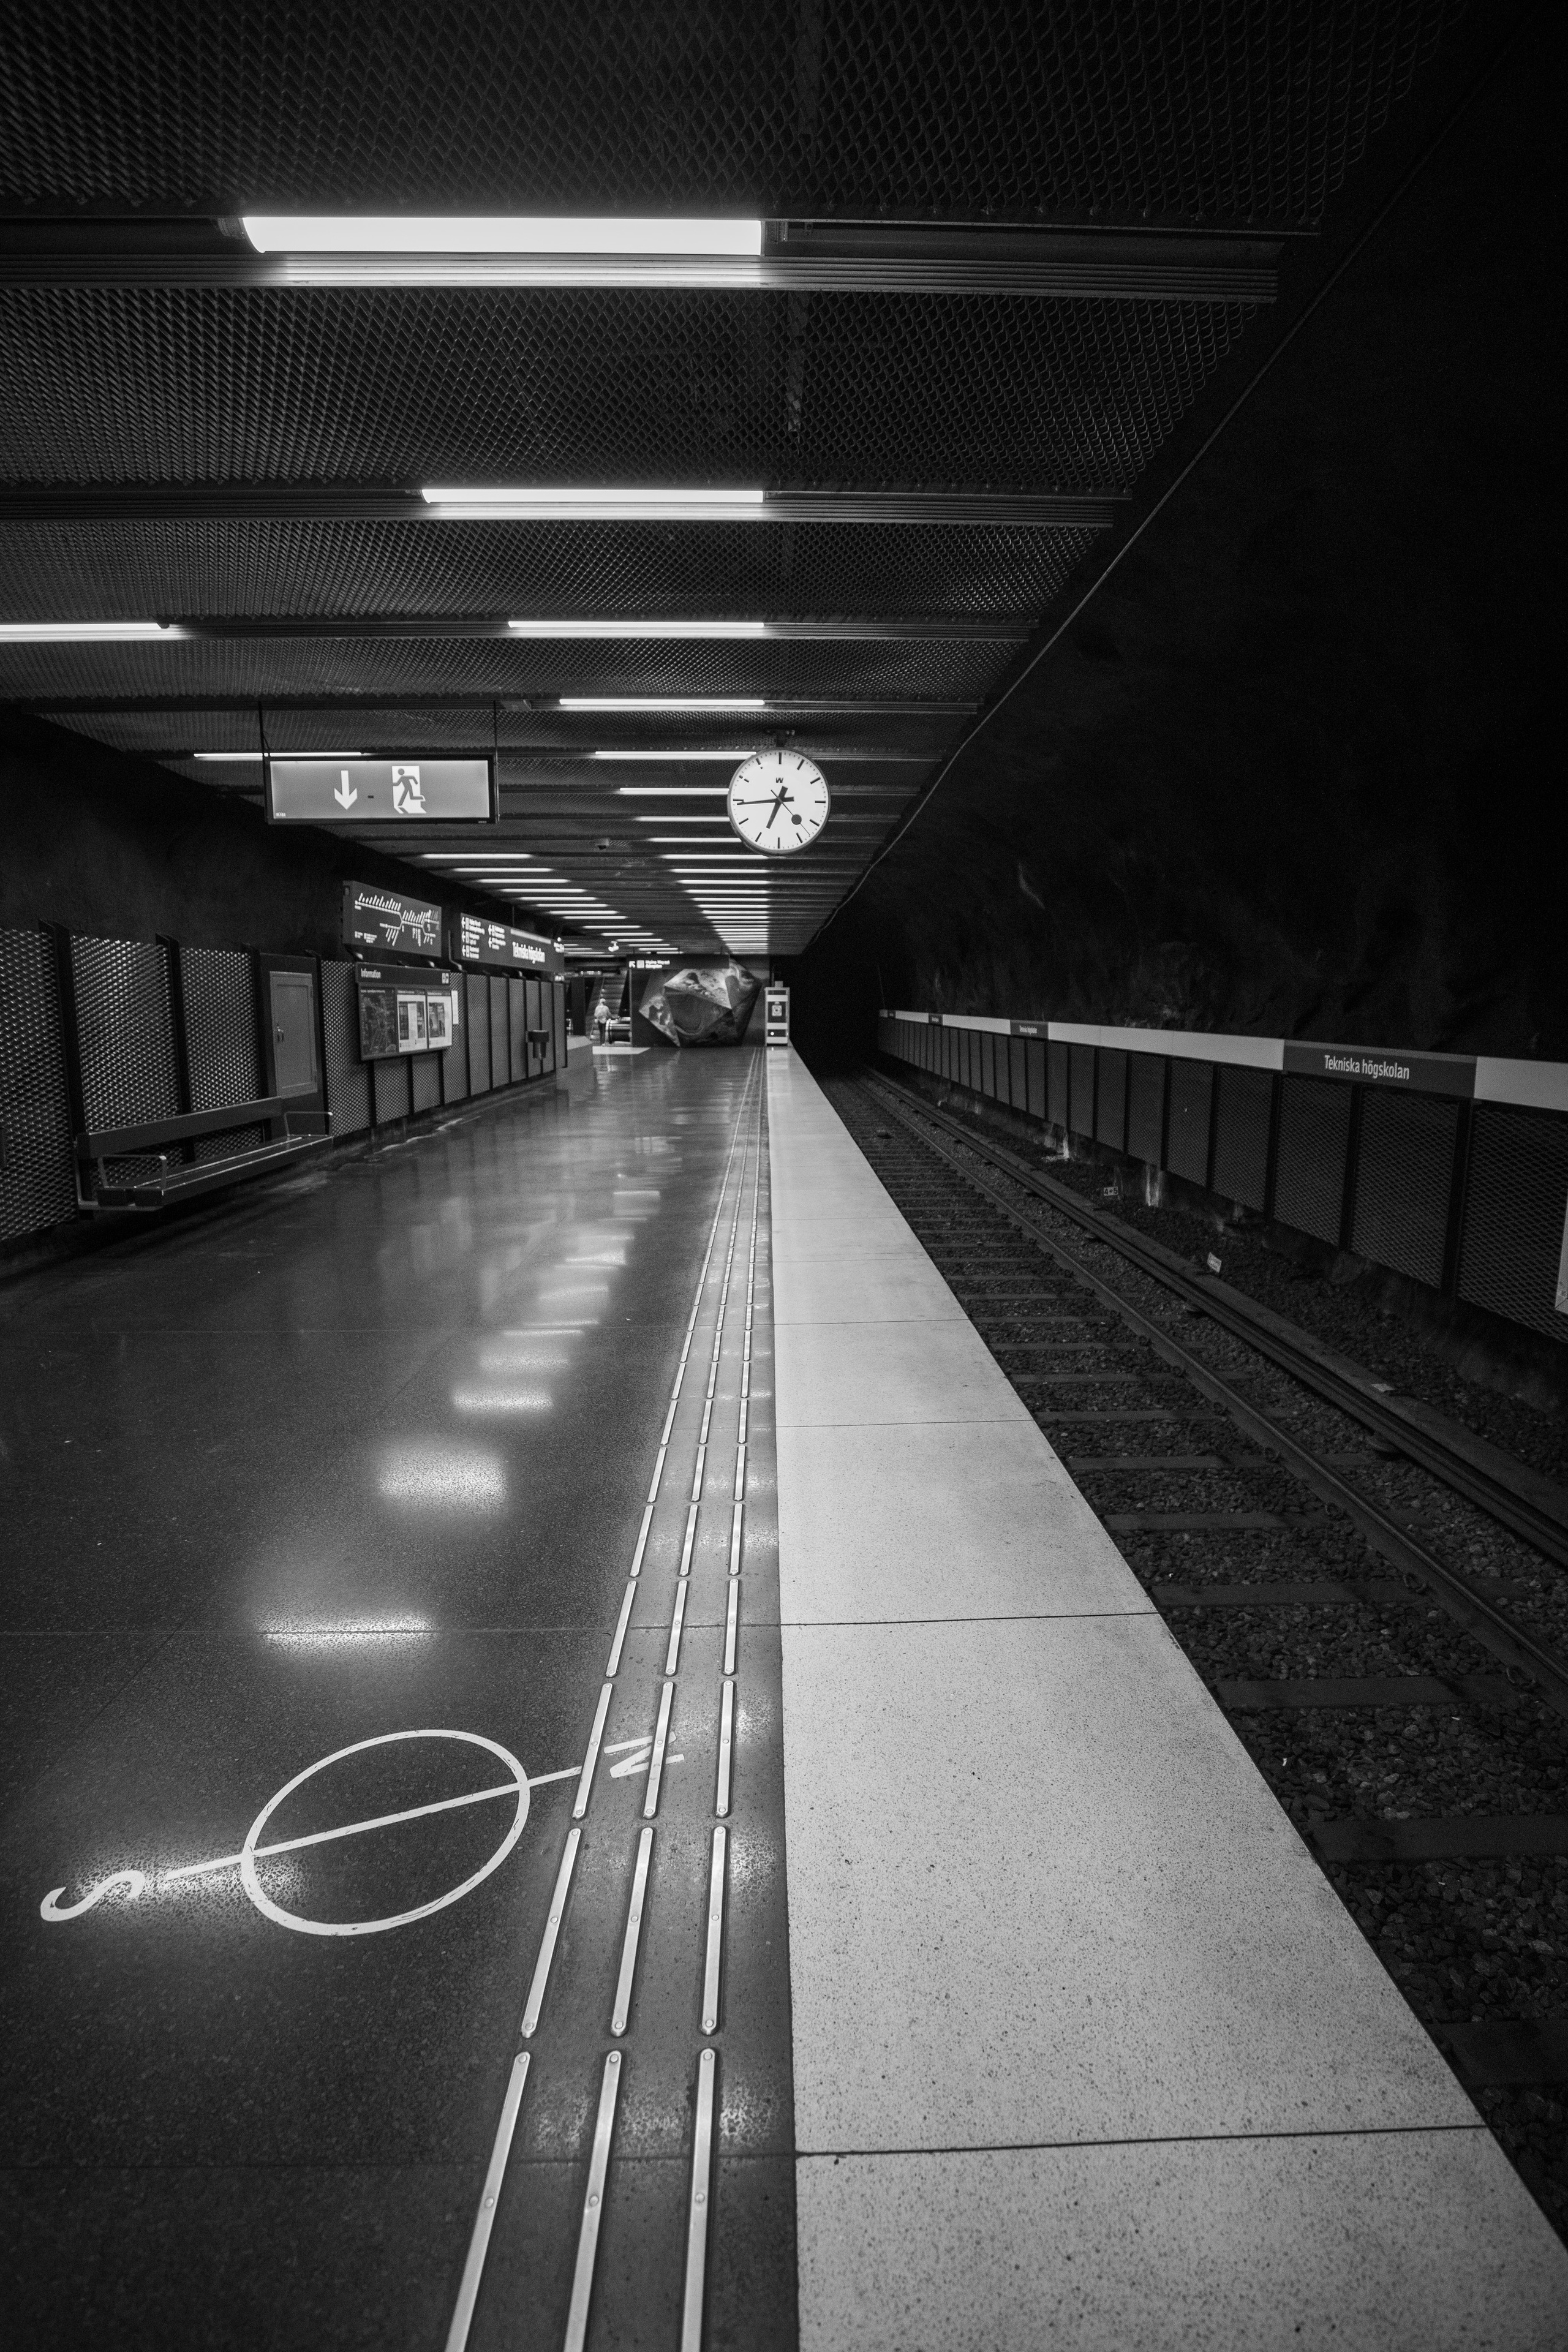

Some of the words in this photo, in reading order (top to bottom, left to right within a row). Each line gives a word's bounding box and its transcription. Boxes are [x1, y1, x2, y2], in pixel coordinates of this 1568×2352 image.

[361, 968, 381, 979] Information
[1324, 1055, 1360, 1073] Tekniska
[1362, 1058, 1410, 1080] högskolan
[40, 1869, 145, 1922] S
